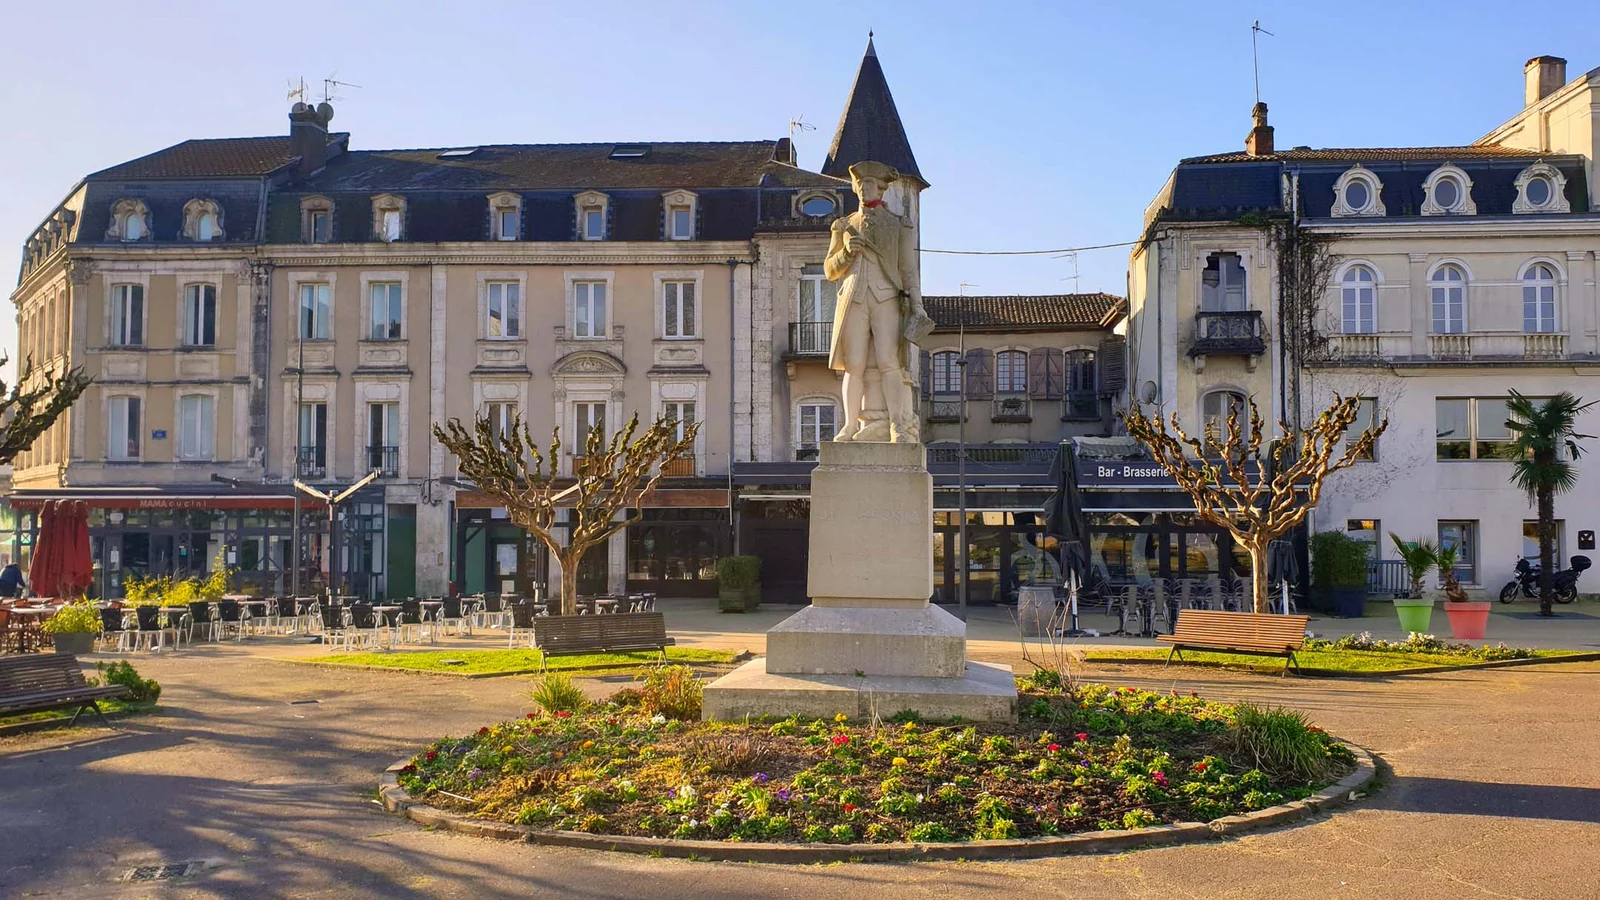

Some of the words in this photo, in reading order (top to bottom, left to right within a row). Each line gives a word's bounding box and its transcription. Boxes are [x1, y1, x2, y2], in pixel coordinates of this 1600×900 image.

[1098, 466, 1115, 477] Bar
[1123, 466, 1169, 477] Brasserie
[140, 500, 167, 508] MAMA
